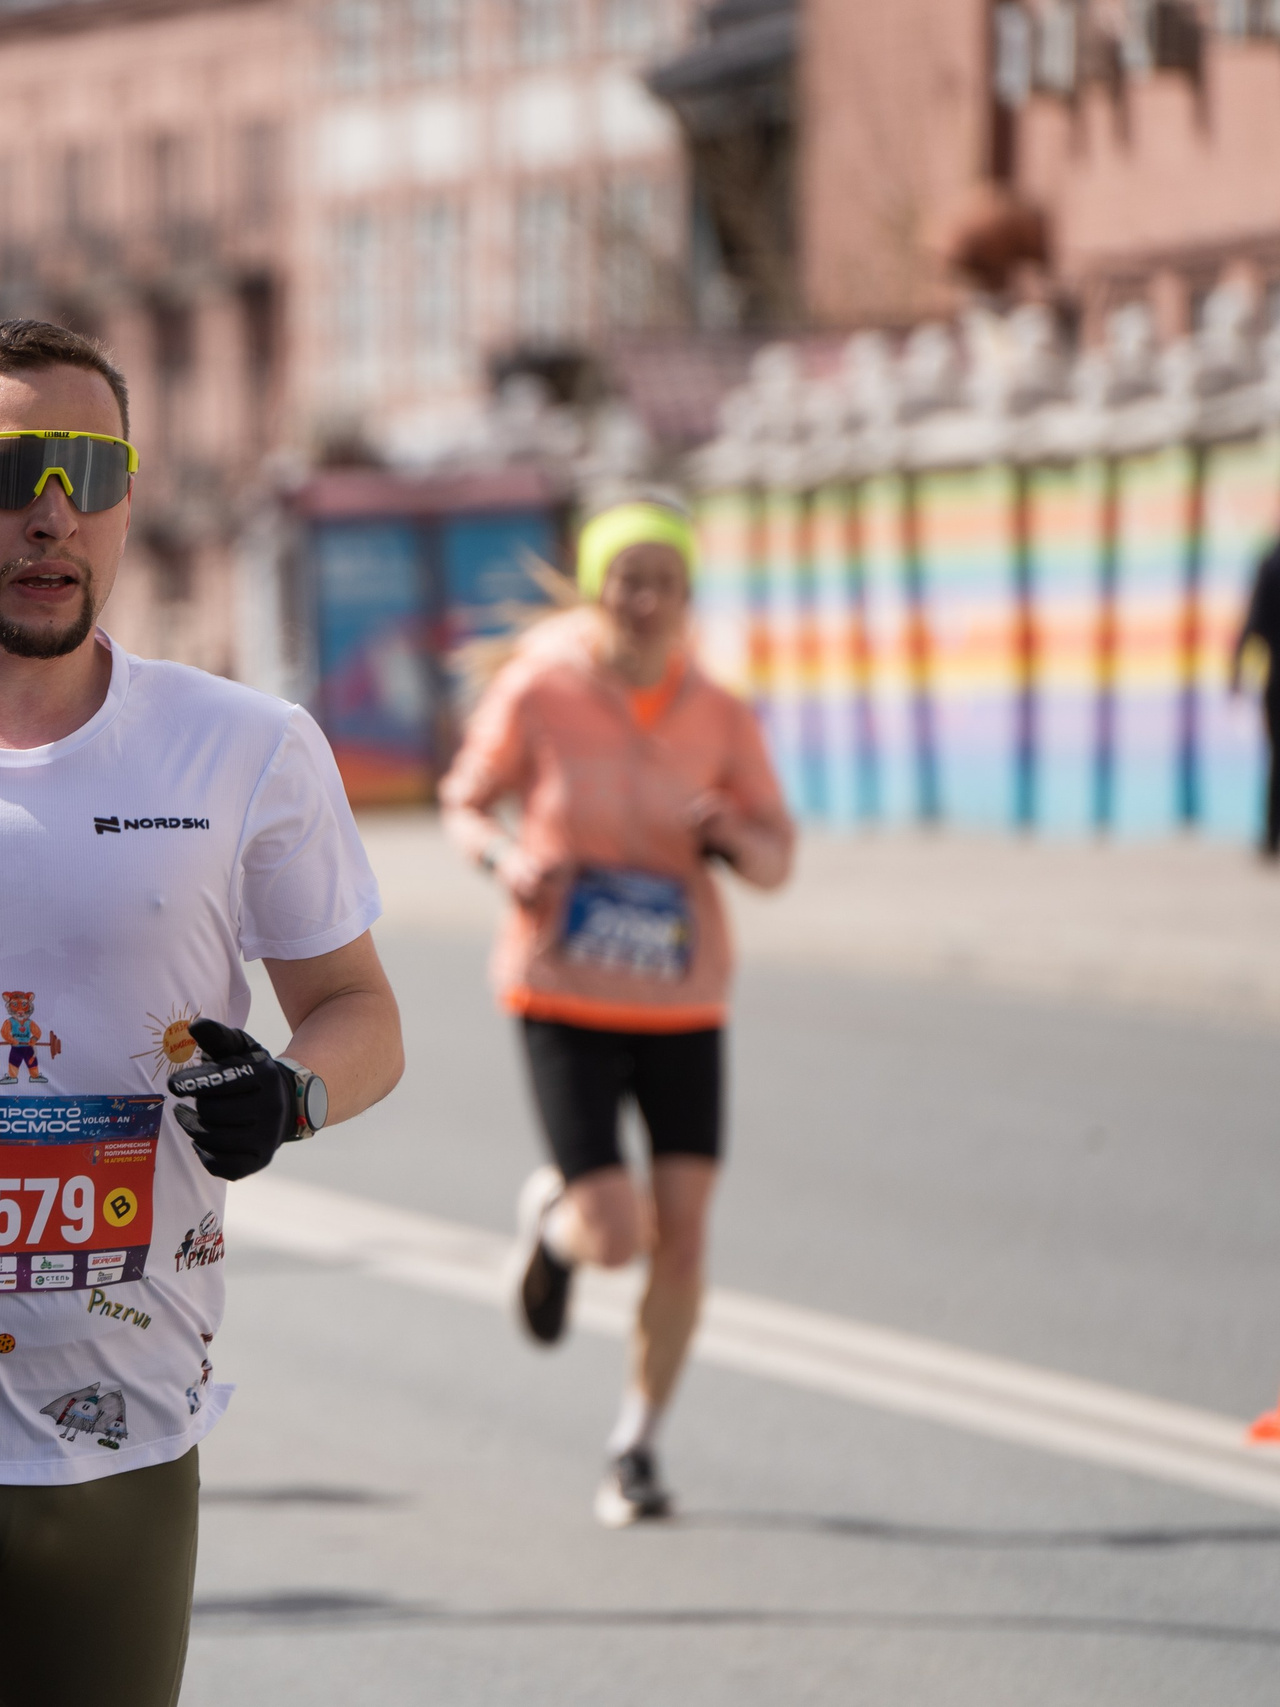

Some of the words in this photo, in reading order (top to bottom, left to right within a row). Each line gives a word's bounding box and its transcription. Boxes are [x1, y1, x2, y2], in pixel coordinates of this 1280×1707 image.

[124, 817, 210, 830] NORDSKI
[173, 1063, 255, 1093] NORDSKI
[104, 1141, 151, 1150] КОСМИЧЕСКИЙ
[104, 1148, 152, 1157] ПОЛУМАРАФОН
[87, 1288, 151, 1330] Pnzrun
